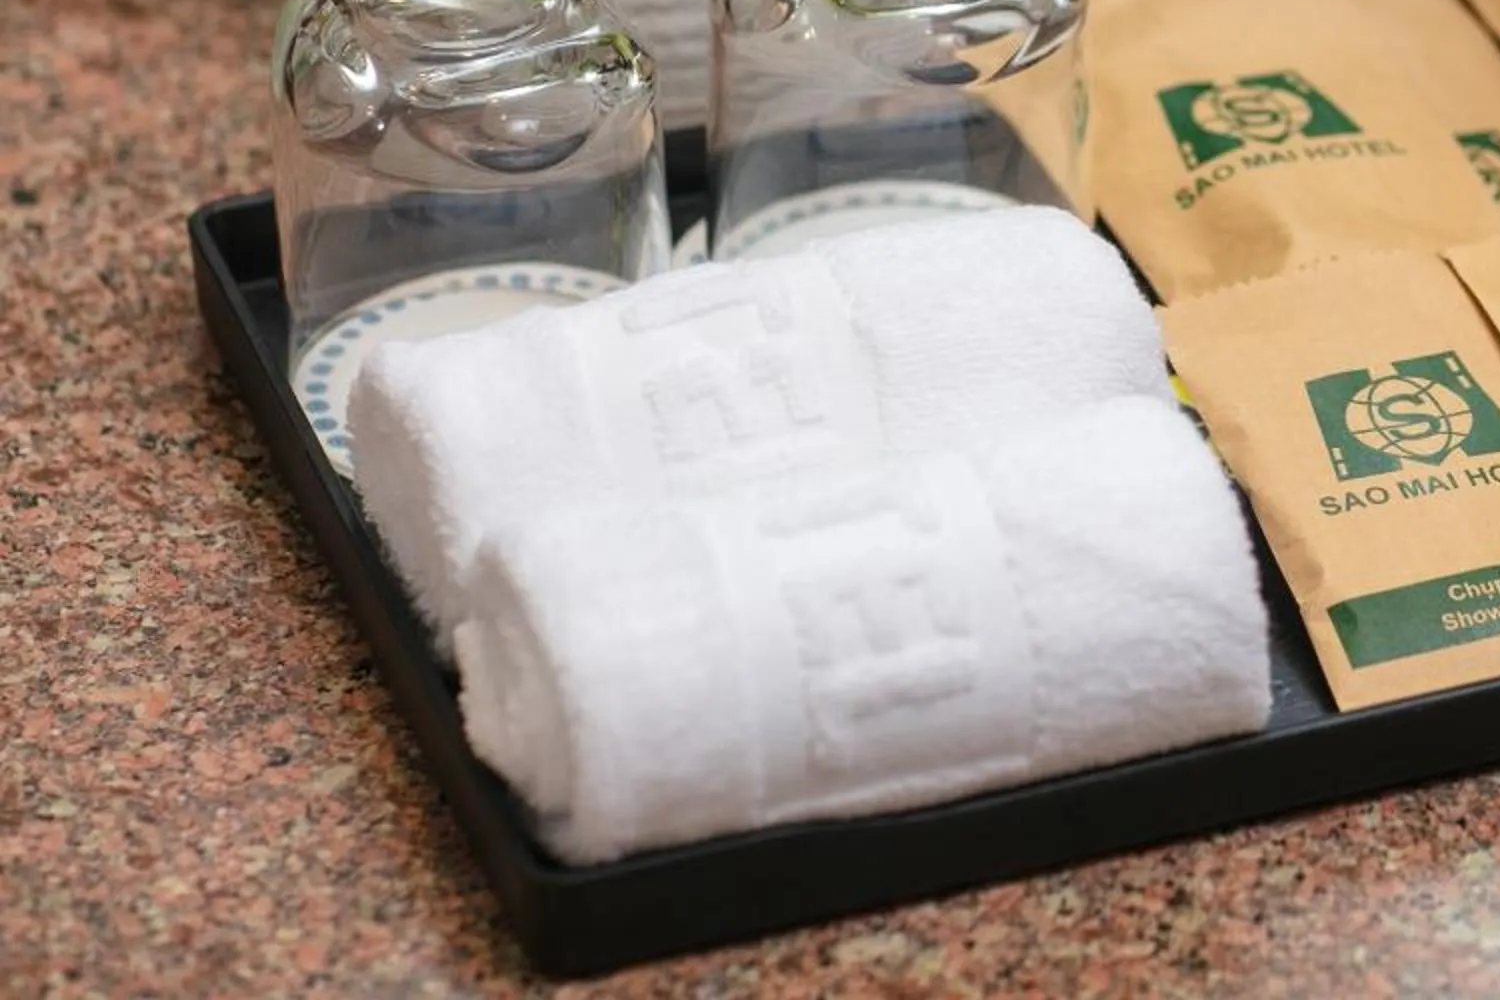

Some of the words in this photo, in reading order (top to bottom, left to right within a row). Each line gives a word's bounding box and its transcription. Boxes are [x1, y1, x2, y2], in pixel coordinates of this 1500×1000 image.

[1174, 164, 1236, 210] SAO
[1241, 149, 1298, 170] MAI
[1303, 139, 1408, 163] HOTEL
[1319, 484, 1390, 516] SAO
[1397, 472, 1459, 500] MAI
